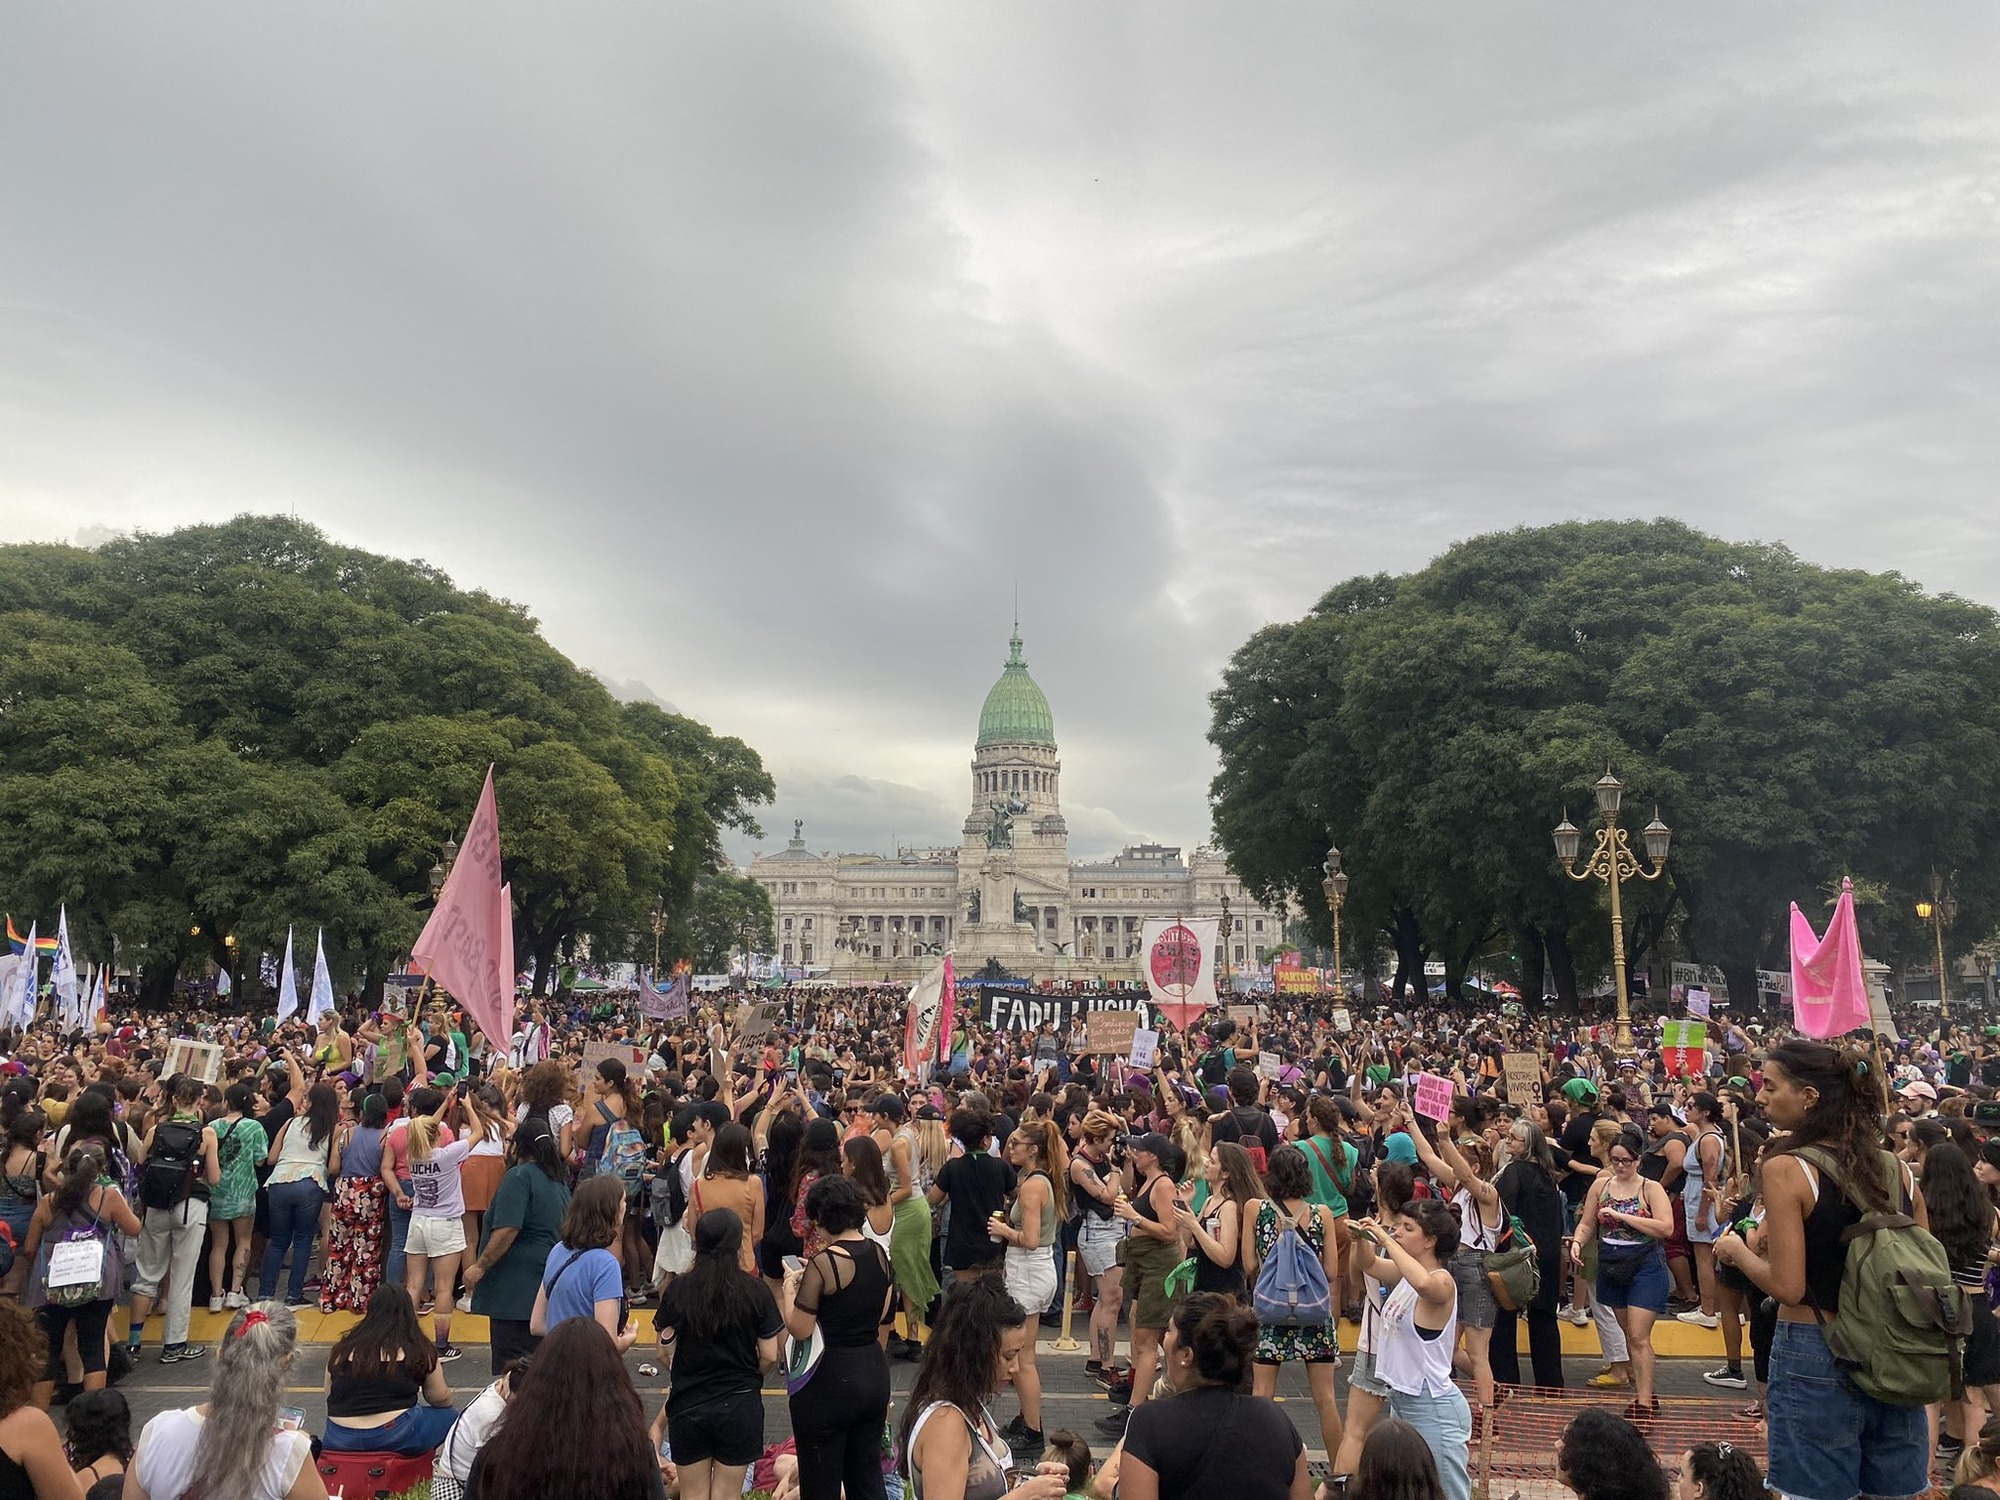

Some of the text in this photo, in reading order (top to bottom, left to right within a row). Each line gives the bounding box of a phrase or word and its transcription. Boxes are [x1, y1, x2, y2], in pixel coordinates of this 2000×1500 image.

[990, 996, 1061, 1032] FADU
[1507, 1071, 1533, 1081] NOSOTRAS
[410, 1163, 441, 1175] UCHA
